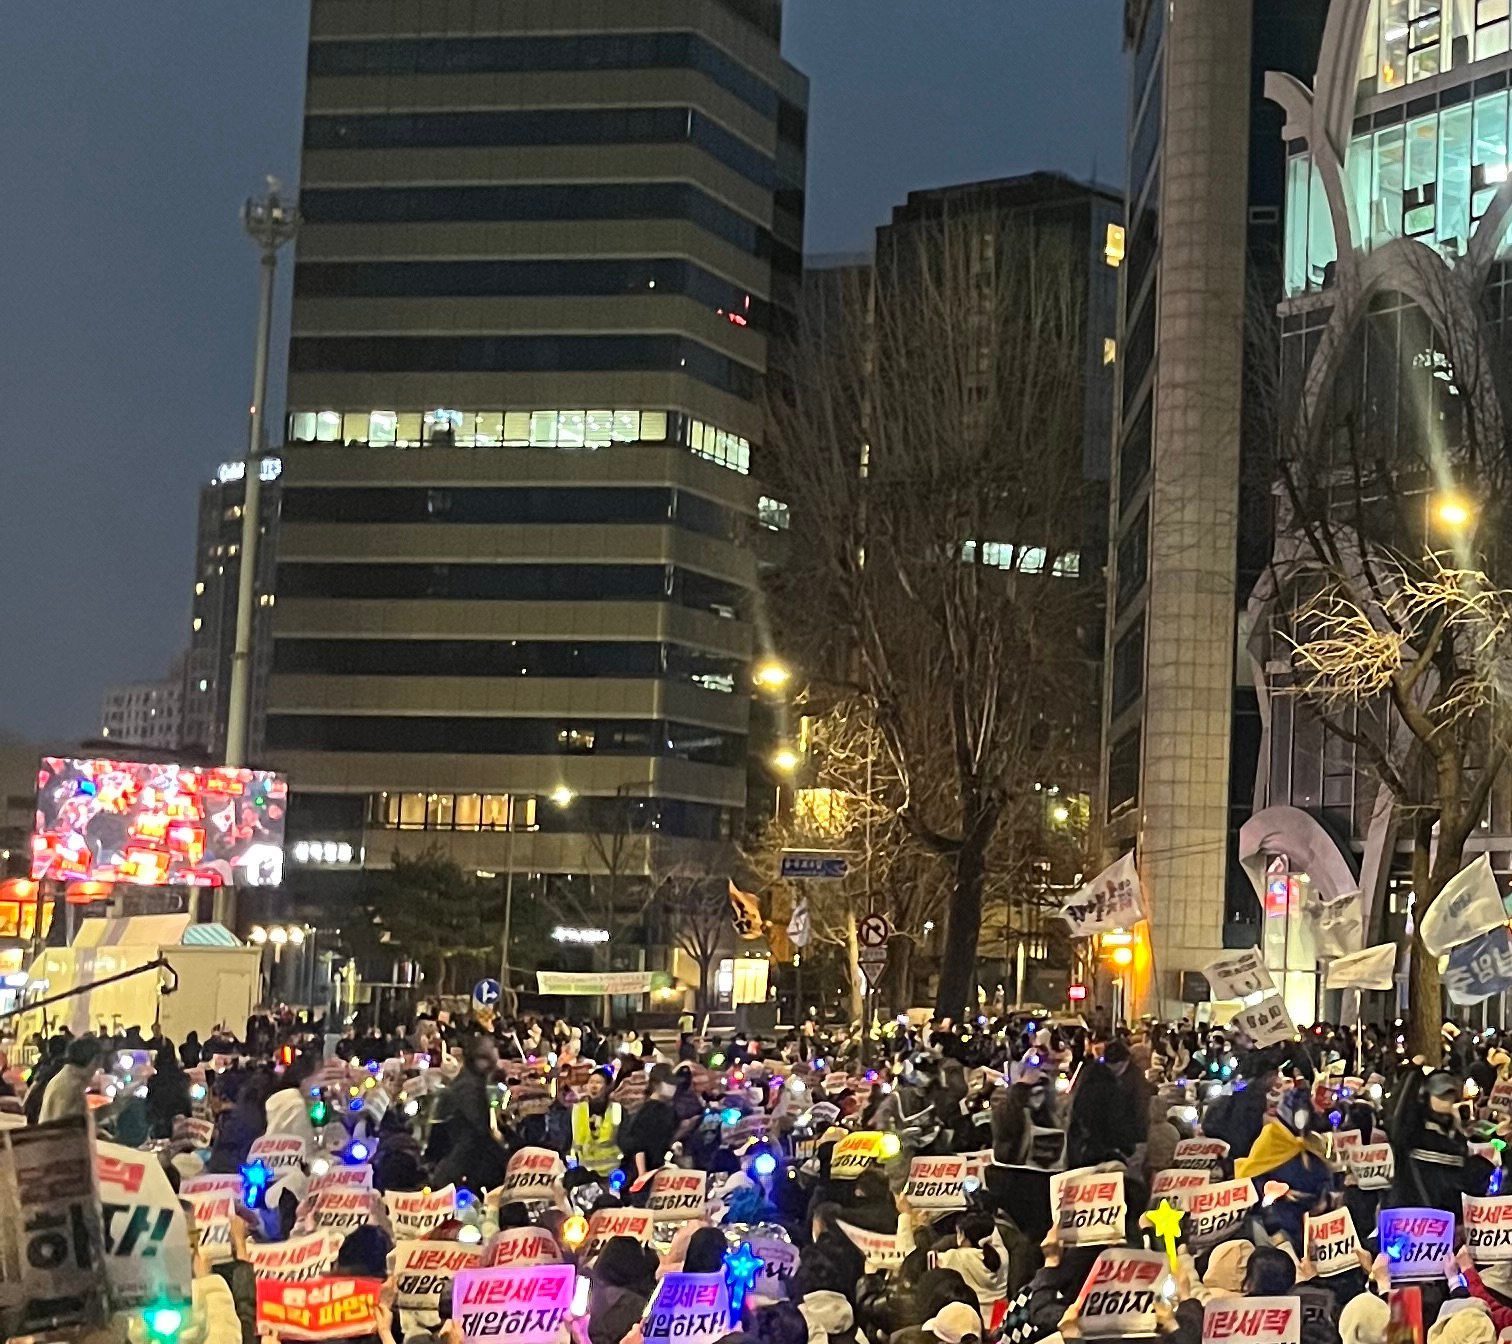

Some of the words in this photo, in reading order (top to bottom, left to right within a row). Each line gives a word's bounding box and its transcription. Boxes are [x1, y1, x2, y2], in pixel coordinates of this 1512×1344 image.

[655, 1176, 701, 1192] 란세력
[594, 1215, 650, 1235] 란세력
[1060, 1205, 1122, 1230] 압하자!
[495, 1238, 558, 1264] 란세력
[1312, 1237, 1356, 1262] 하자!
[1092, 1258, 1165, 1285] 란세력
[462, 1275, 566, 1306] 내란세력
[659, 1283, 720, 1308] 란세력
[1078, 1289, 1158, 1319] 압하자!
[461, 1306, 568, 1337] 제압하자!
